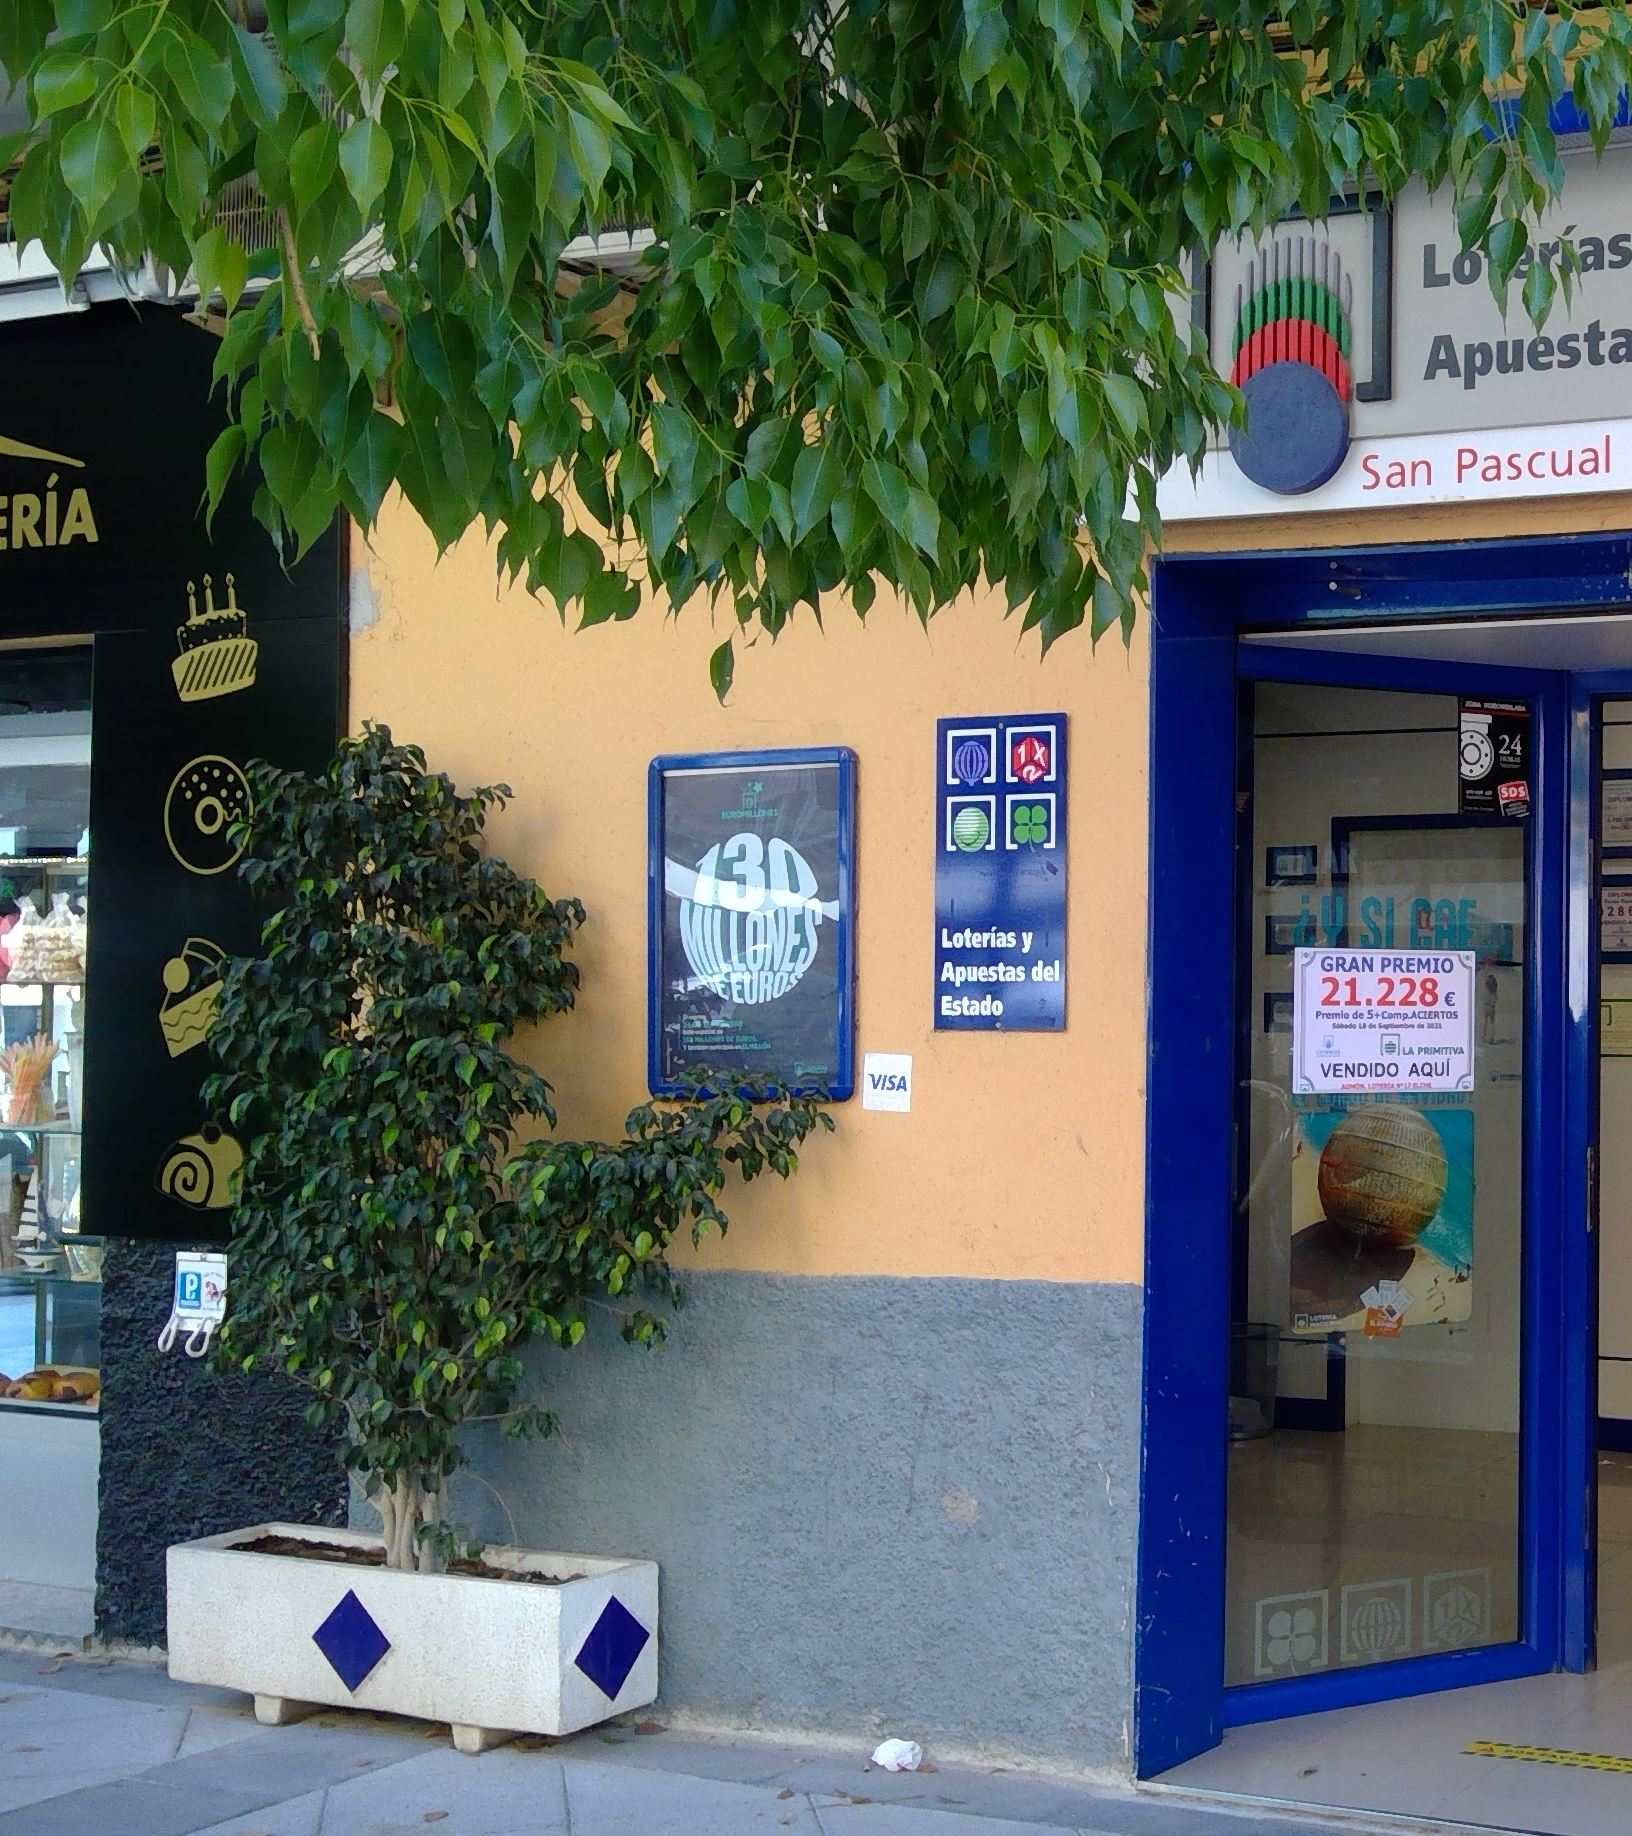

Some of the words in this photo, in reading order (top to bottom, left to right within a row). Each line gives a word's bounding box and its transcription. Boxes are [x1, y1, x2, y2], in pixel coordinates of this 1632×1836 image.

[1423, 225, 1632, 289] Loerías
[1361, 454, 1432, 490] San
[1456, 435, 1612, 483] Pascual
[1498, 733, 1522, 756] 24
[1500, 786, 1526, 799] SDS
[680, 897, 823, 980] MILLONES
[942, 926, 1016, 949] Loterías
[1022, 931, 1033, 954] y
[940, 961, 1026, 987] Apuestas
[1031, 959, 1060, 982] del
[1320, 956, 1374, 973] GRAN
[1380, 957, 1454, 974] PREMIO
[730, 970, 805, 1005] EUROS
[1320, 976, 1439, 1007] 21.228
[941, 994, 1004, 1016] Estado
[1315, 1010, 1350, 1020] Premio
[1352, 1010, 1365, 1020] de
[1417, 1046, 1465, 1056] PRIMITIVA
[1320, 1062, 1399, 1078] VENDIDO
[1408, 1058, 1450, 1078] AQUÍ
[868, 1073, 907, 1092] VISA
